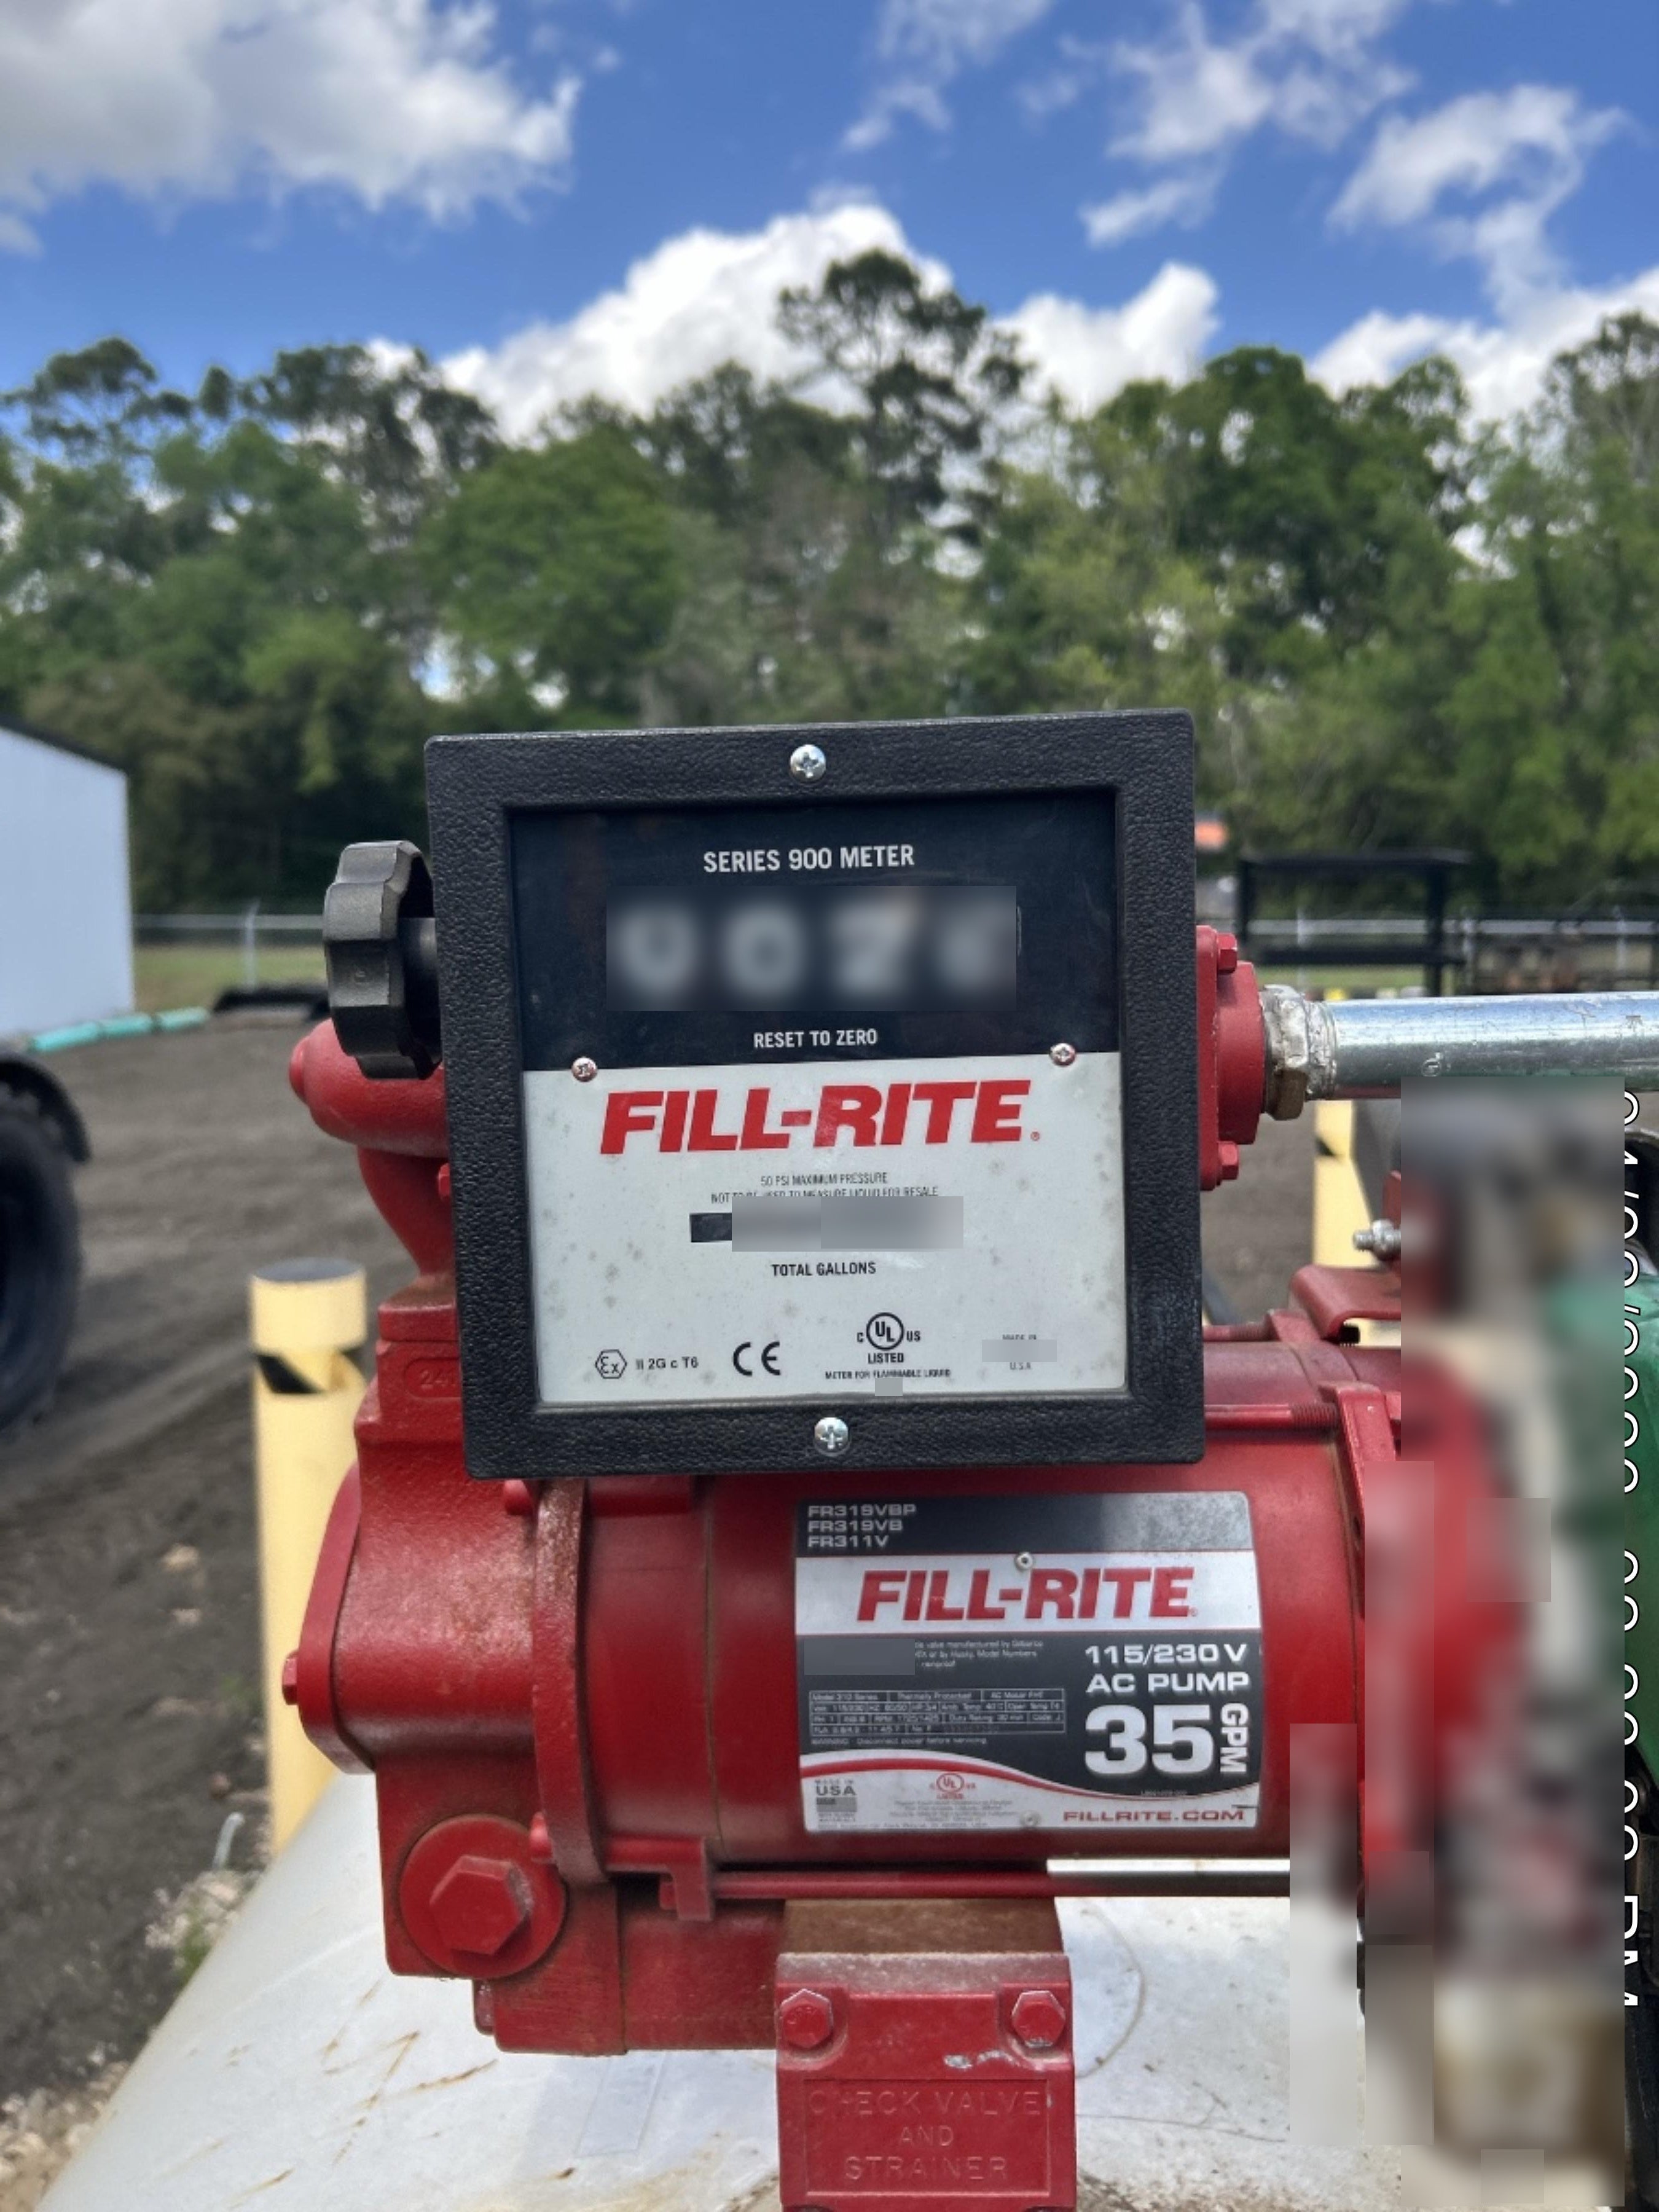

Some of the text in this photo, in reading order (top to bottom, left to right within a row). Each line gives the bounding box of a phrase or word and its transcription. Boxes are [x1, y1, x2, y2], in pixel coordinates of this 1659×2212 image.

[704, 844, 916, 873] SERIES 900 METER
[753, 1029, 878, 1048] RESET TO ZERO
[600, 1079, 1032, 1155] FILL-RITE
[760, 1172, 888, 1187] 50 PSI MAXIMUM PRESSURE
[711, 1192, 730, 1204] NOT
[772, 1261, 876, 1277] TOTAL GALLONS
[906, 1330, 921, 1342] US
[681, 1356, 699, 1369] T6
[733, 1341, 782, 1377] CE
[868, 1352, 904, 1364] LISTED
[825, 1371, 852, 1379] METER
[855, 1370, 870, 1379] FOR
[808, 1519, 903, 1532] FR319VB
[807, 1534, 889, 1548] FR311V
[856, 1567, 1194, 1622] FILL-RITE
[1085, 1643, 1248, 1667] 115/230 V
[1085, 1671, 1250, 1693] AC PUMP
[1084, 1704, 1214, 1775] 35
[1220, 1702, 1249, 1773] GPM
[816, 1786, 857, 1796] USA
[1064, 1809, 1244, 1822] FILLRITE.COM
[809, 2090, 1041, 2116] CHECK VALVE
[898, 2124, 955, 2147] AND
[844, 2155, 1008, 2181] STRAINER
